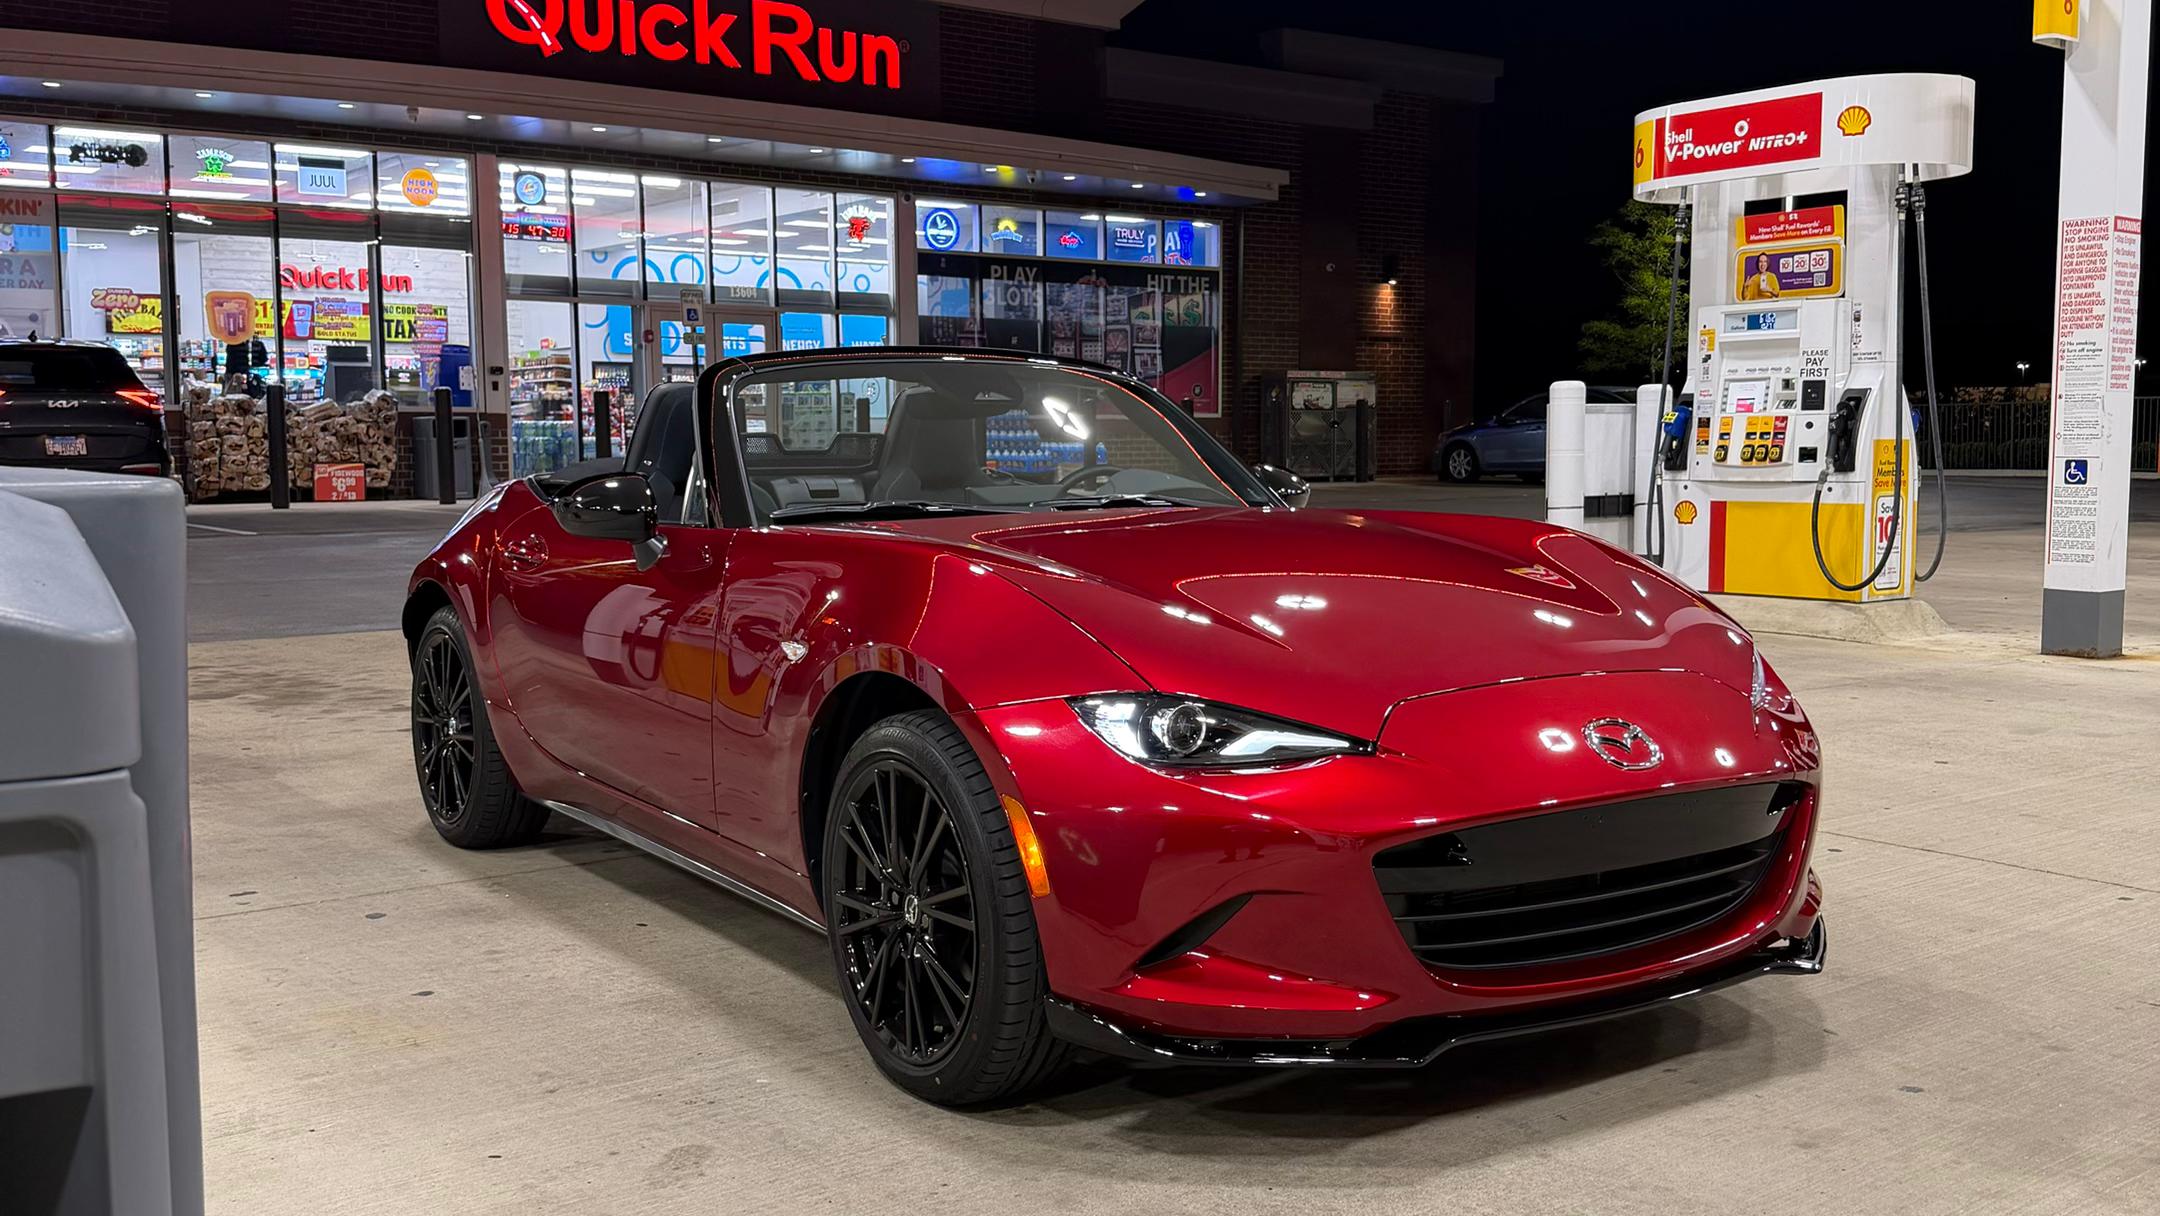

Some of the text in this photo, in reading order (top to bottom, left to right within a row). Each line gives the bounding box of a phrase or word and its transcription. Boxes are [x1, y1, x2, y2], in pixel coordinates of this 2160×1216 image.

[487, 0, 901, 88] Quick Run
[1666, 128, 1693, 146] Shell
[1634, 135, 1645, 169] 6
[1665, 140, 1740, 163] V-Power
[308, 174, 337, 189] JUUL
[408, 178, 433, 188] HIGH
[406, 187, 434, 197] NOON
[2066, 218, 2109, 228] WARNING
[551, 226, 566, 237] 30
[1115, 227, 1145, 240] TRULY
[2065, 226, 2110, 236] STOP ENGINE
[1147, 231, 1182, 254] PAY
[2078, 234, 2110, 242] SMOKING
[2076, 243, 2104, 252] UNLAWFUL
[2076, 250, 2108, 259] DANGEROUS
[20, 258, 36, 276] A
[2084, 266, 2108, 274] GASOLINE
[280, 264, 356, 291] Quick
[990, 264, 1038, 286] PLAY
[2075, 274, 2106, 282] UNAPPROVED
[19, 279, 44, 289] DAY
[1147, 274, 1210, 294] HIT THE
[2062, 282, 2095, 290] CONTAINERS
[2074, 292, 2102, 300] UNLAWFUL
[2074, 298, 2106, 307] DANGEROUS
[395, 305, 418, 316] COOK
[2070, 307, 2094, 315] DISPENSE
[2084, 314, 2106, 322] WITHOUT
[384, 318, 418, 339] TAX
[782, 339, 821, 351] NERGY
[1805, 358, 1825, 366] PAY
[1800, 368, 1830, 378] FIRST
[1874, 478, 1890, 488] Save
[1880, 502, 1894, 514] Sav
